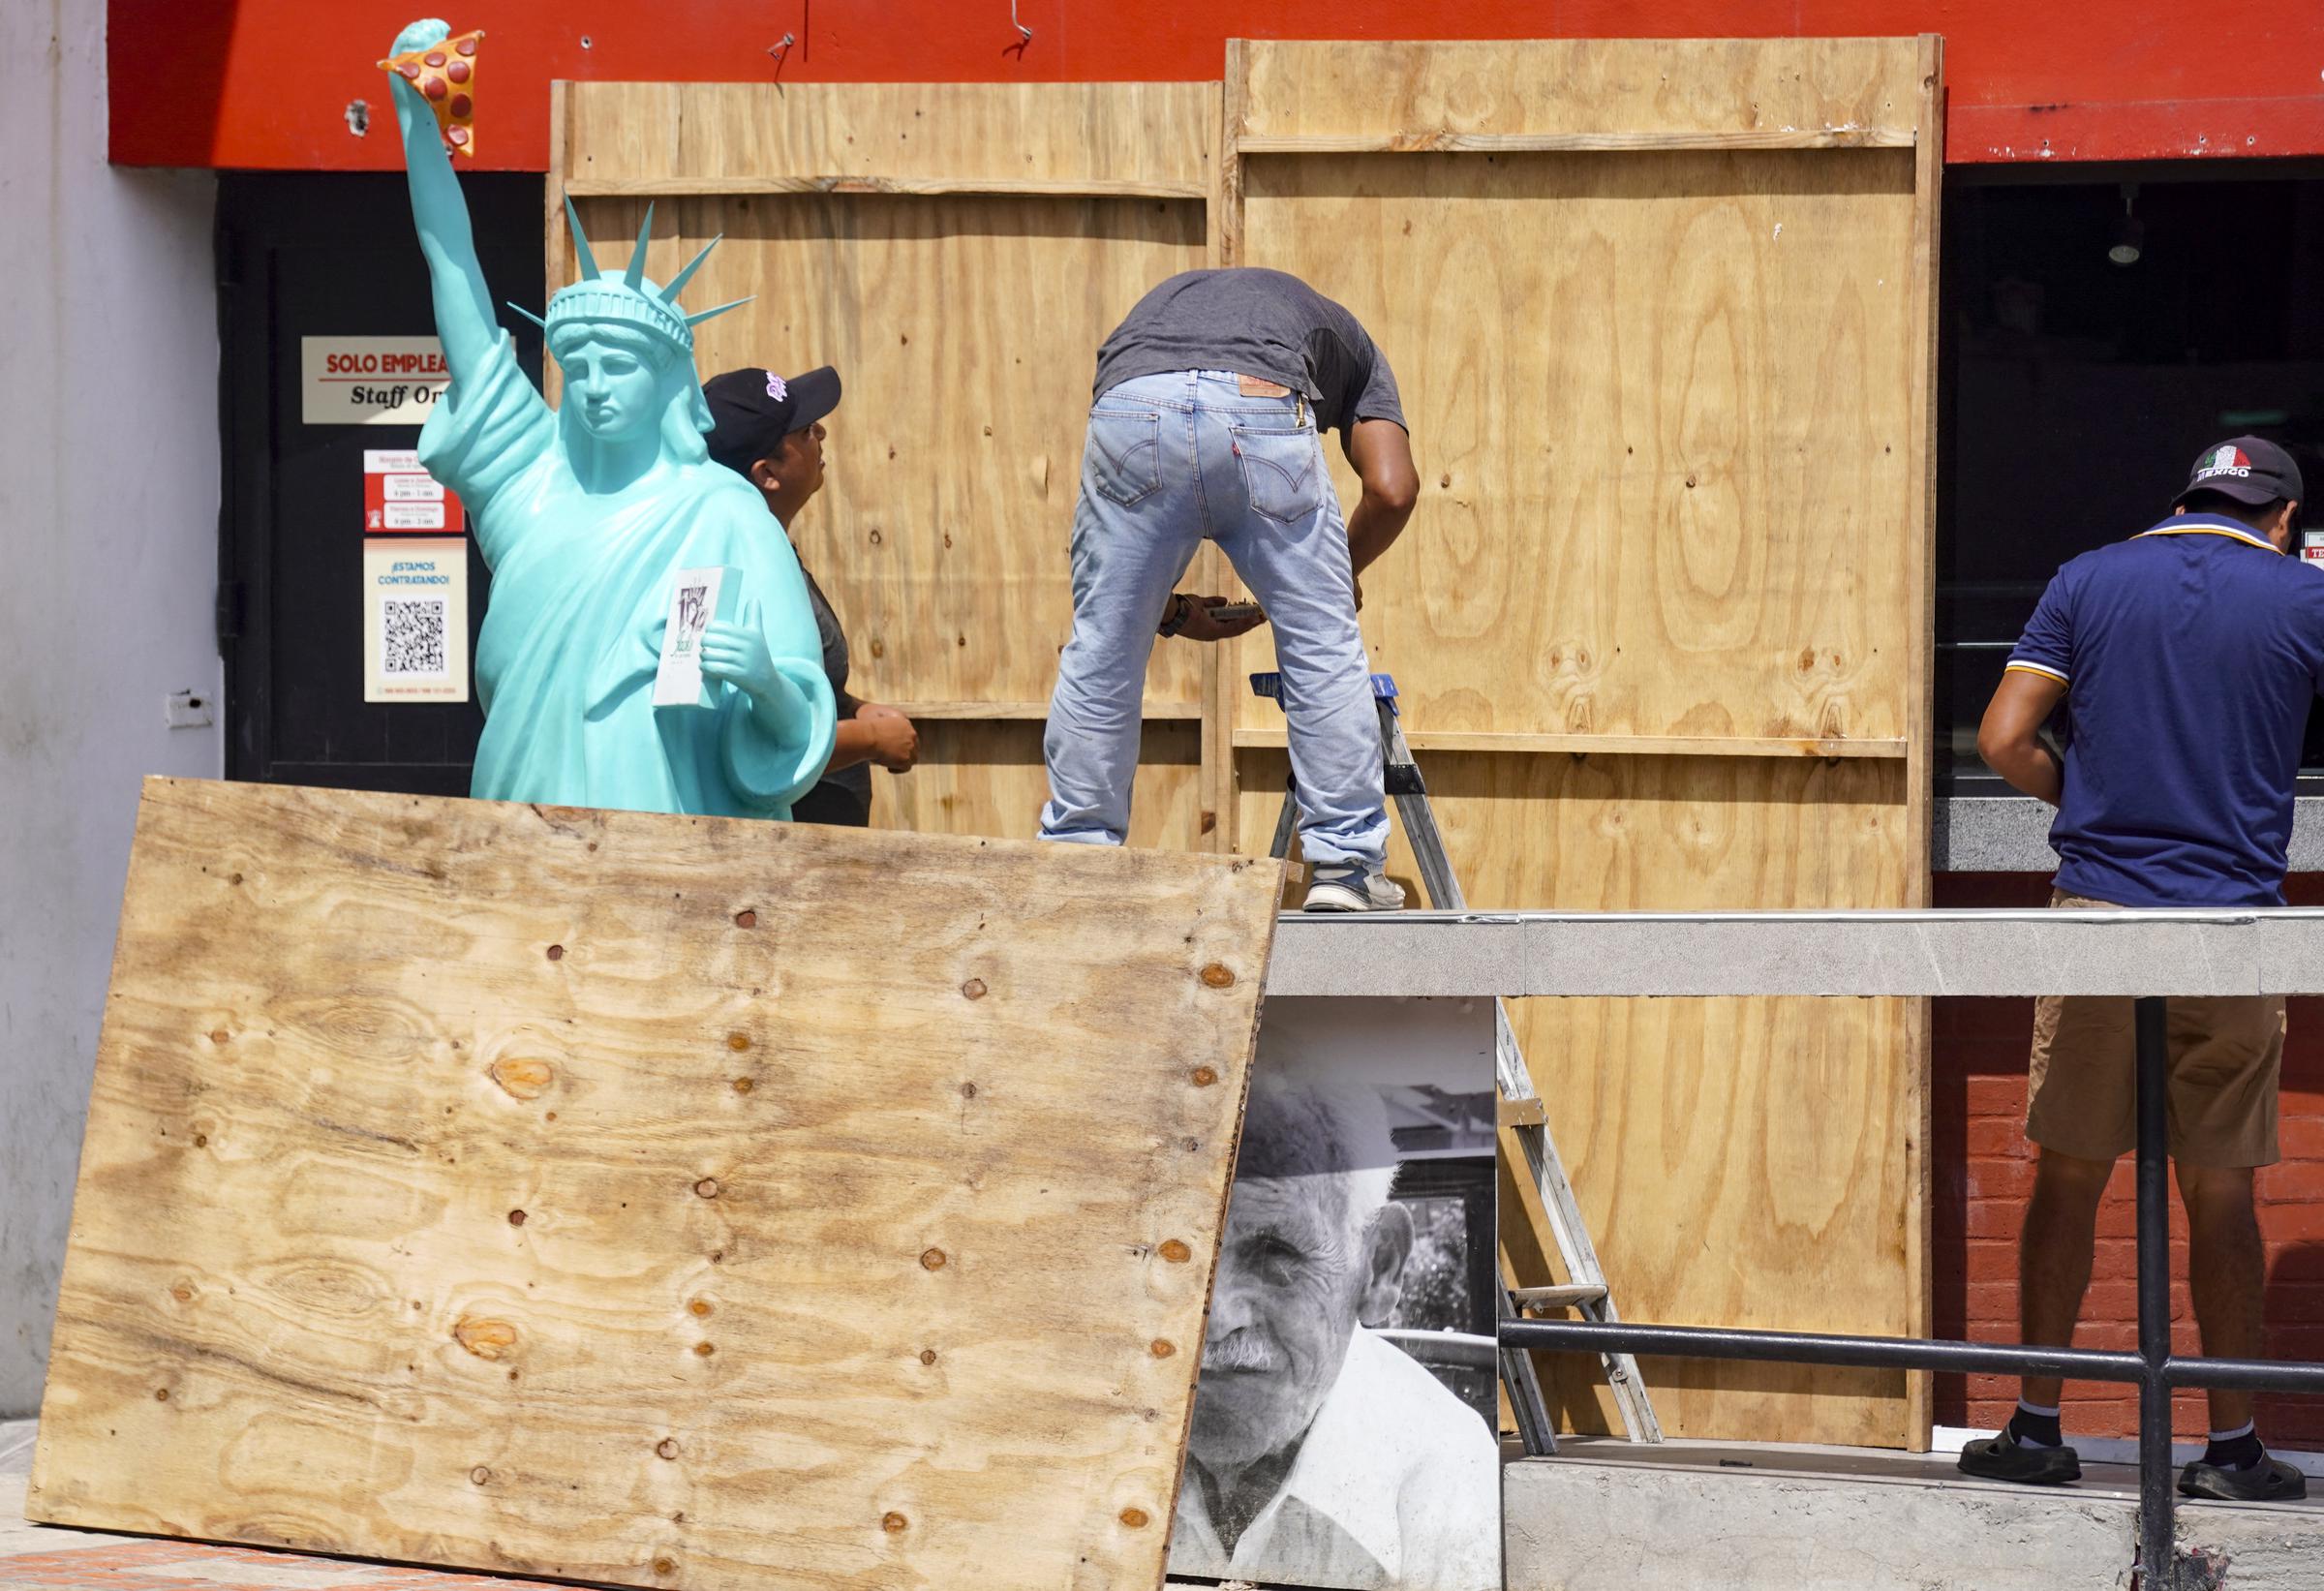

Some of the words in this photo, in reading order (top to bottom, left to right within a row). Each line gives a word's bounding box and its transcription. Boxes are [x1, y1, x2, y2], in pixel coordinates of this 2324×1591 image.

[326, 353, 377, 374] SOLO
[382, 353, 449, 374] EMPLEA
[351, 385, 409, 410] Staff
[2196, 469, 2249, 481] MEXICO
[378, 575, 449, 585] CONTRATANDO!
